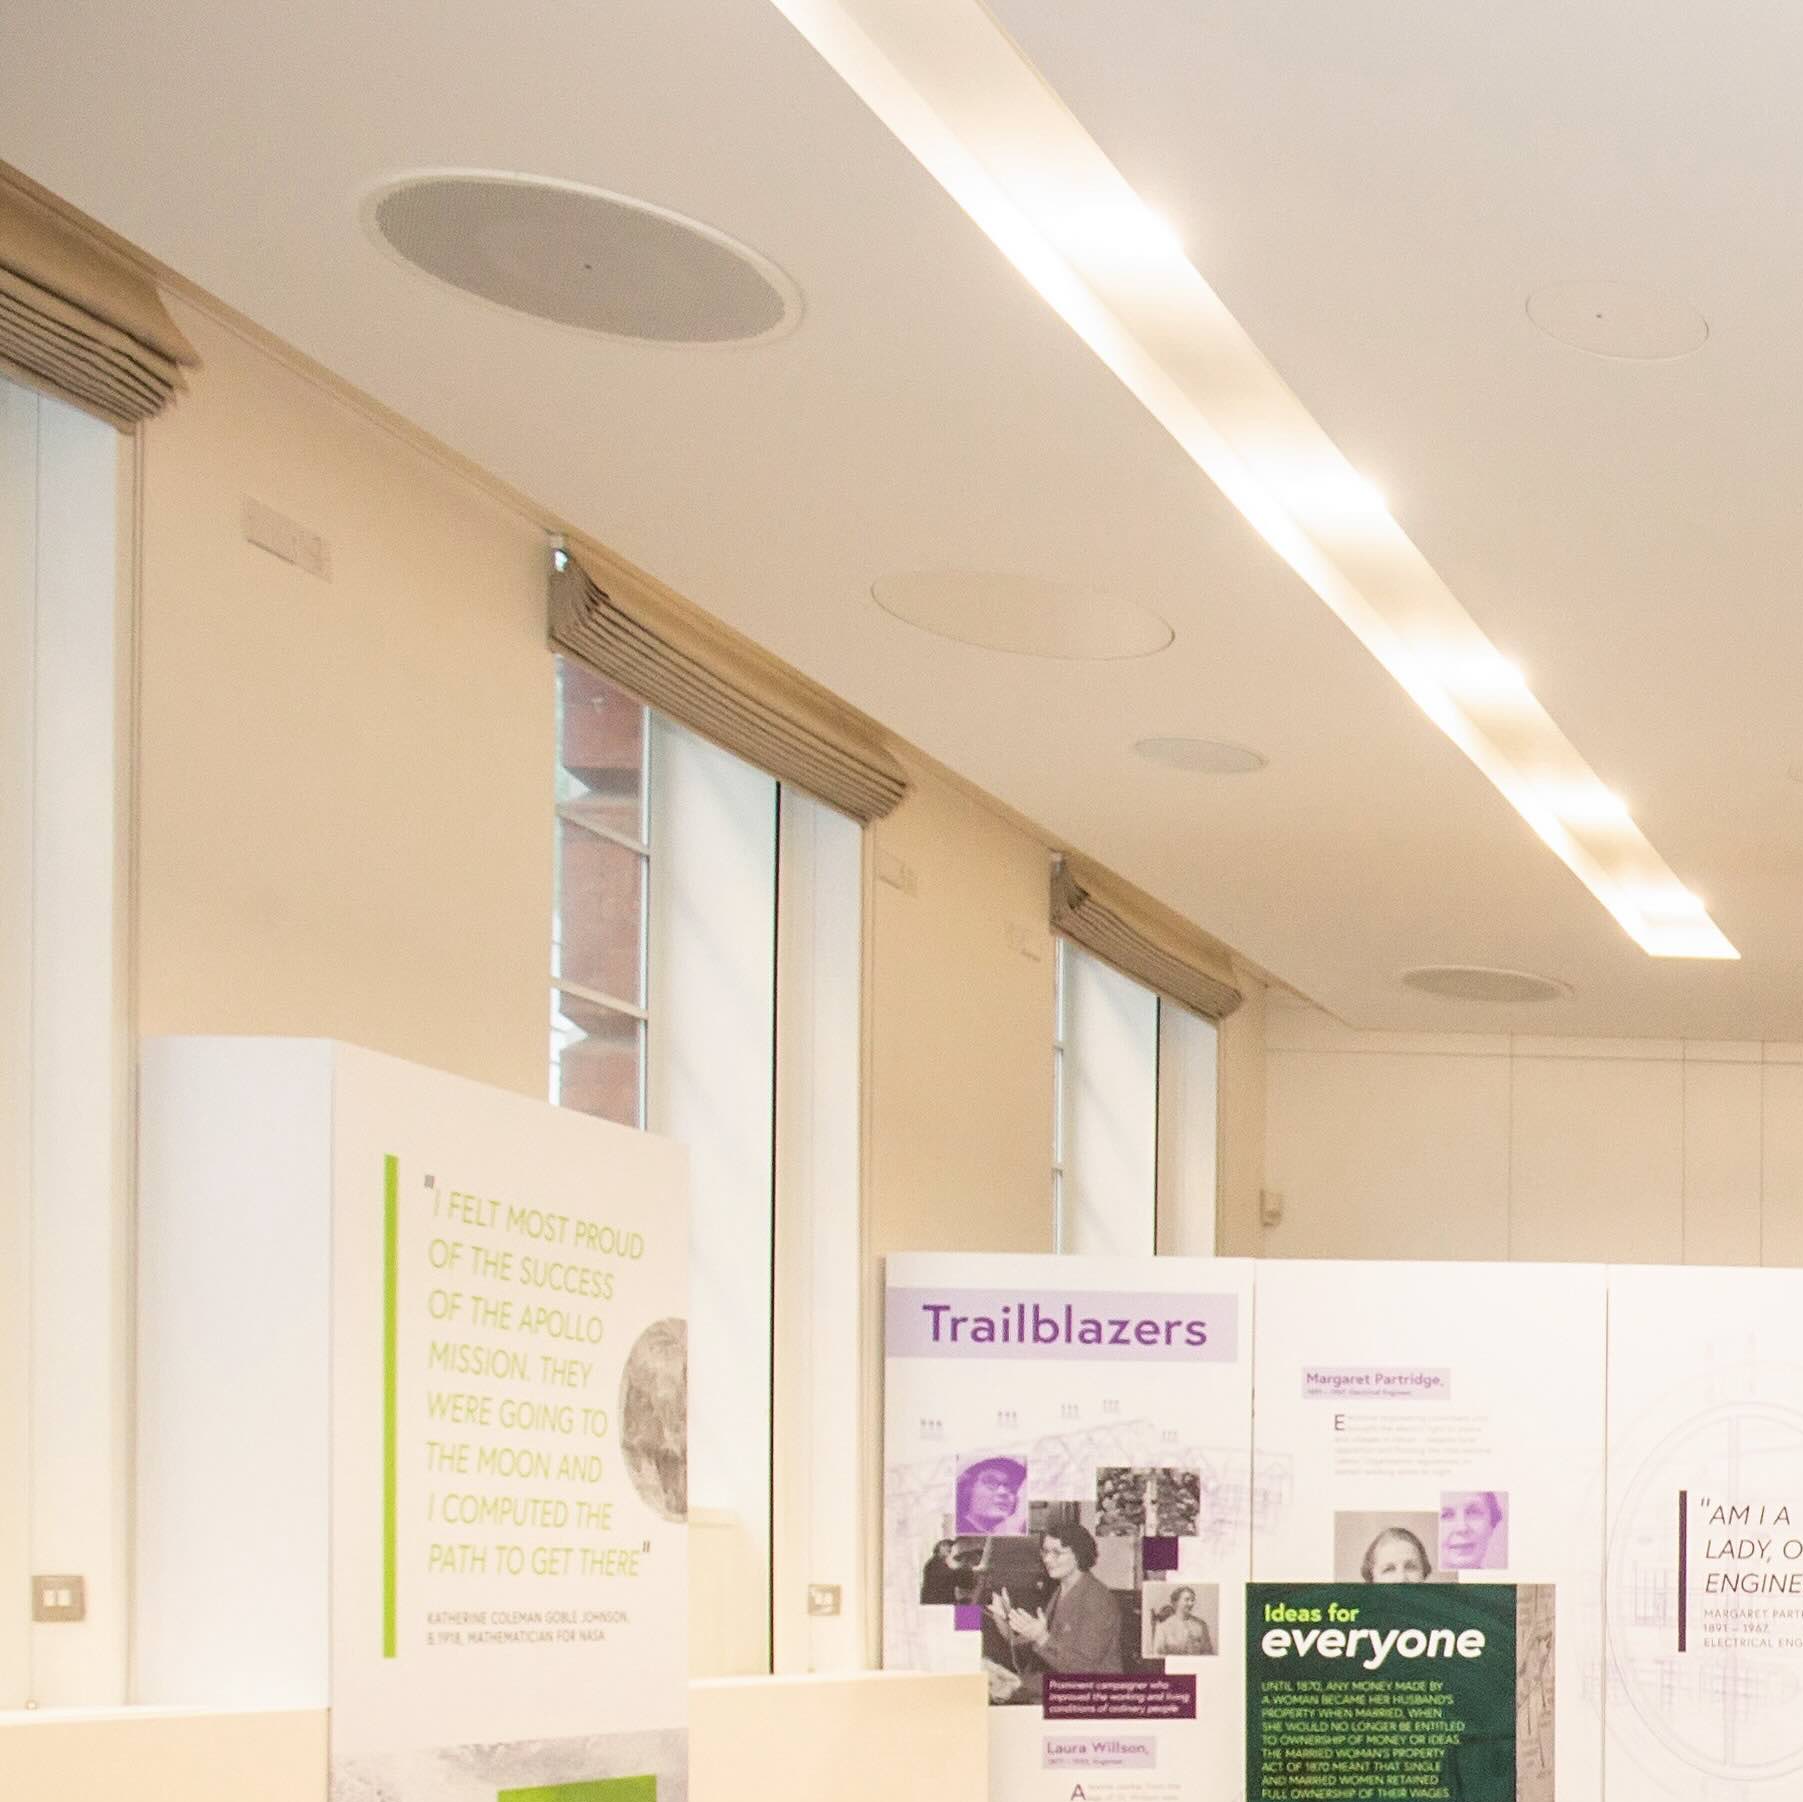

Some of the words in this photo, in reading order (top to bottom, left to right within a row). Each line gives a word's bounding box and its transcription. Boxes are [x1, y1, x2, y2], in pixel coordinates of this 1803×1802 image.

[428, 1239, 464, 1269] OF
[471, 1245, 513, 1281] THE
[519, 1256, 614, 1301] SUCCESS
[428, 1290, 463, 1320] OF
[471, 1295, 513, 1331] THE
[519, 1306, 602, 1344] APOLLO
[922, 1303, 1207, 1346] Trailblazers
[429, 1341, 526, 1380] MISSION.
[540, 1355, 591, 1388] THEY
[1306, 1372, 1370, 1389] Margaret
[1375, 1373, 1444, 1389] Partridge,
[1759, 1505, 1766, 1525] I
[1773, 1506, 1791, 1526] A
[429, 1543, 486, 1572] PATH
[495, 1544, 525, 1576] TO
[531, 1546, 574, 1576] GET
[1705, 1539, 1772, 1563] LADY,
[1265, 1602, 1322, 1622] Ideas
[1328, 1602, 1360, 1622] for
[1261, 1628, 1486, 1670] everyone
[1047, 1741, 1087, 1754] Laura
[1092, 1741, 1149, 1754] Willson,
